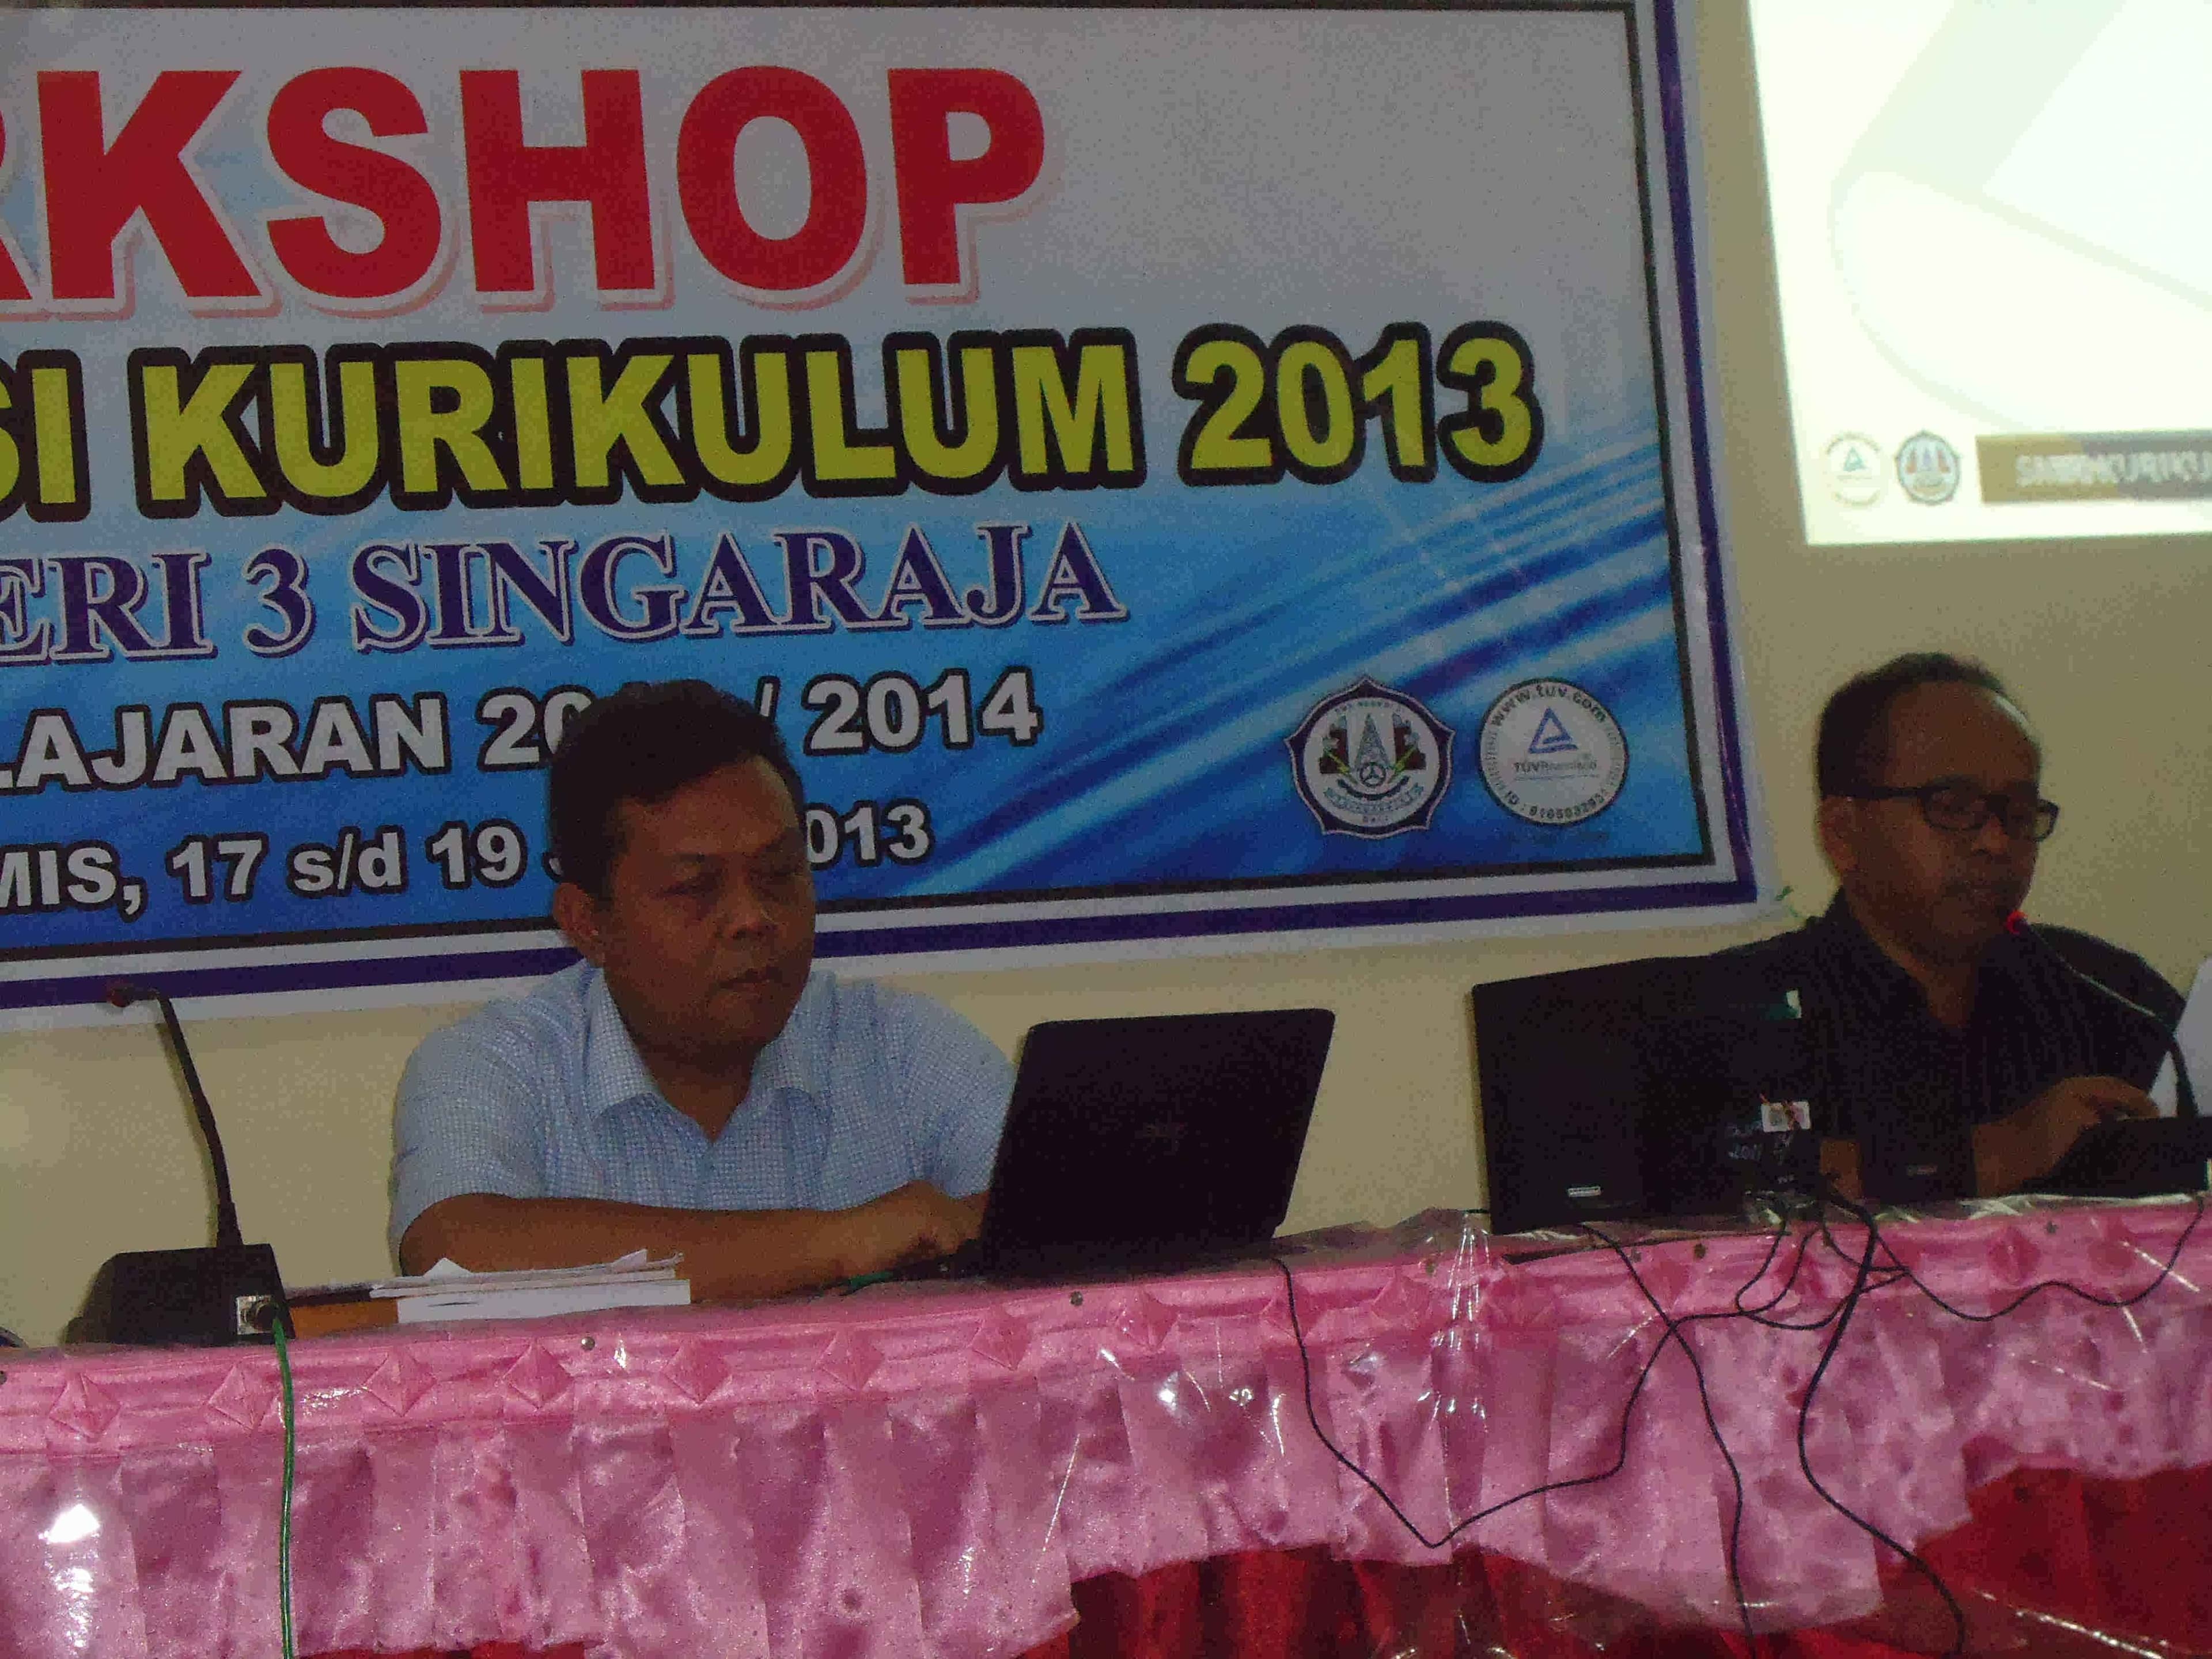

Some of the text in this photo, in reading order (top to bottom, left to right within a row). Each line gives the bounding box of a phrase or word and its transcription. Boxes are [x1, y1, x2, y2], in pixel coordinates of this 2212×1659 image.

[0, 66, 1045, 301] KSHOP
[0, 320, 1544, 522] I KURIKULUM 2013
[243, 542, 317, 658] 3
[350, 520, 1131, 655] SINGARAJA
[0, 691, 452, 795] AJARAN
[476, 684, 596, 772] 20
[801, 665, 1043, 756] 2014
[164, 831, 269, 904] 17
[285, 823, 408, 897] s/d
[425, 819, 528, 890] 19
[804, 798, 934, 871] 013
